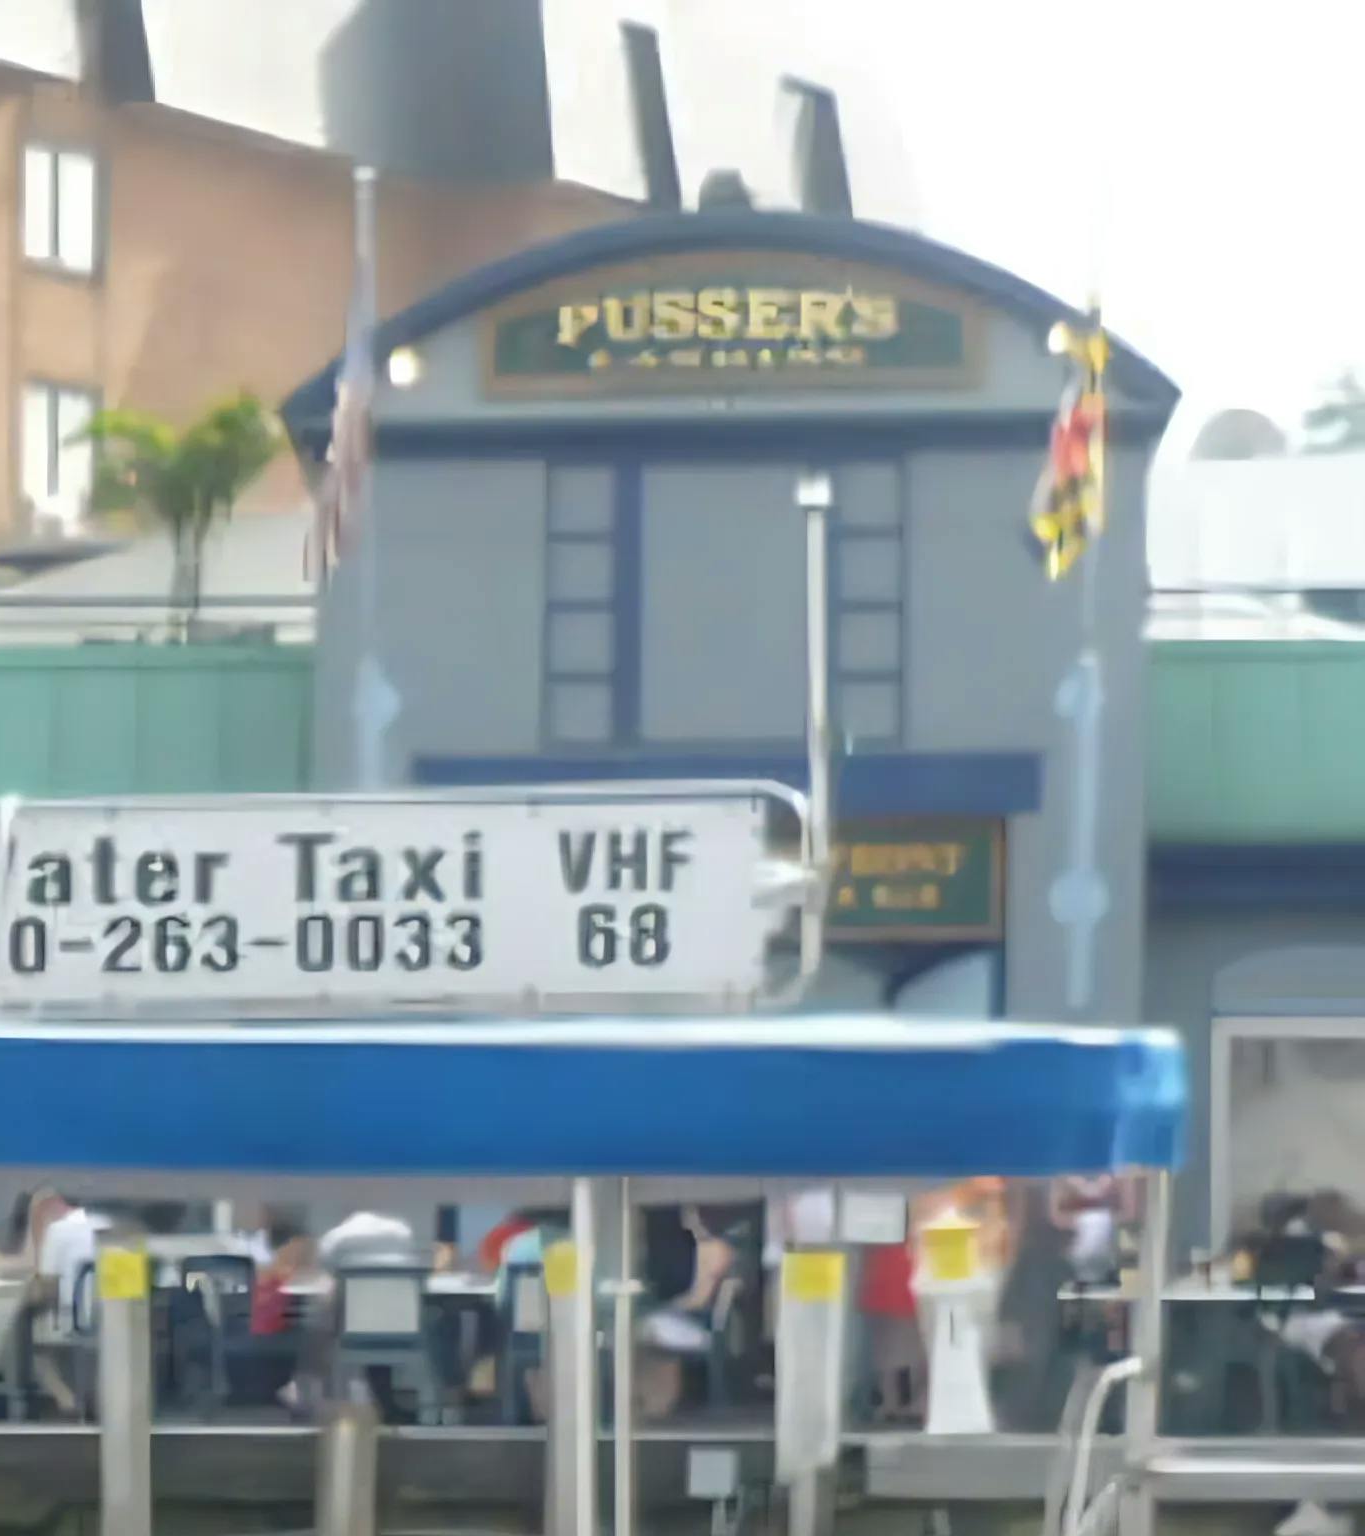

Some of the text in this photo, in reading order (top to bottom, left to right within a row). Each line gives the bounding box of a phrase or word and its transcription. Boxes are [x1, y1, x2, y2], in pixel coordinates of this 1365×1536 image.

[556, 284, 900, 347] PUSSER'S
[276, 831, 483, 902] Taxi
[557, 829, 696, 894] VHF
[577, 902, 670, 967] 68
